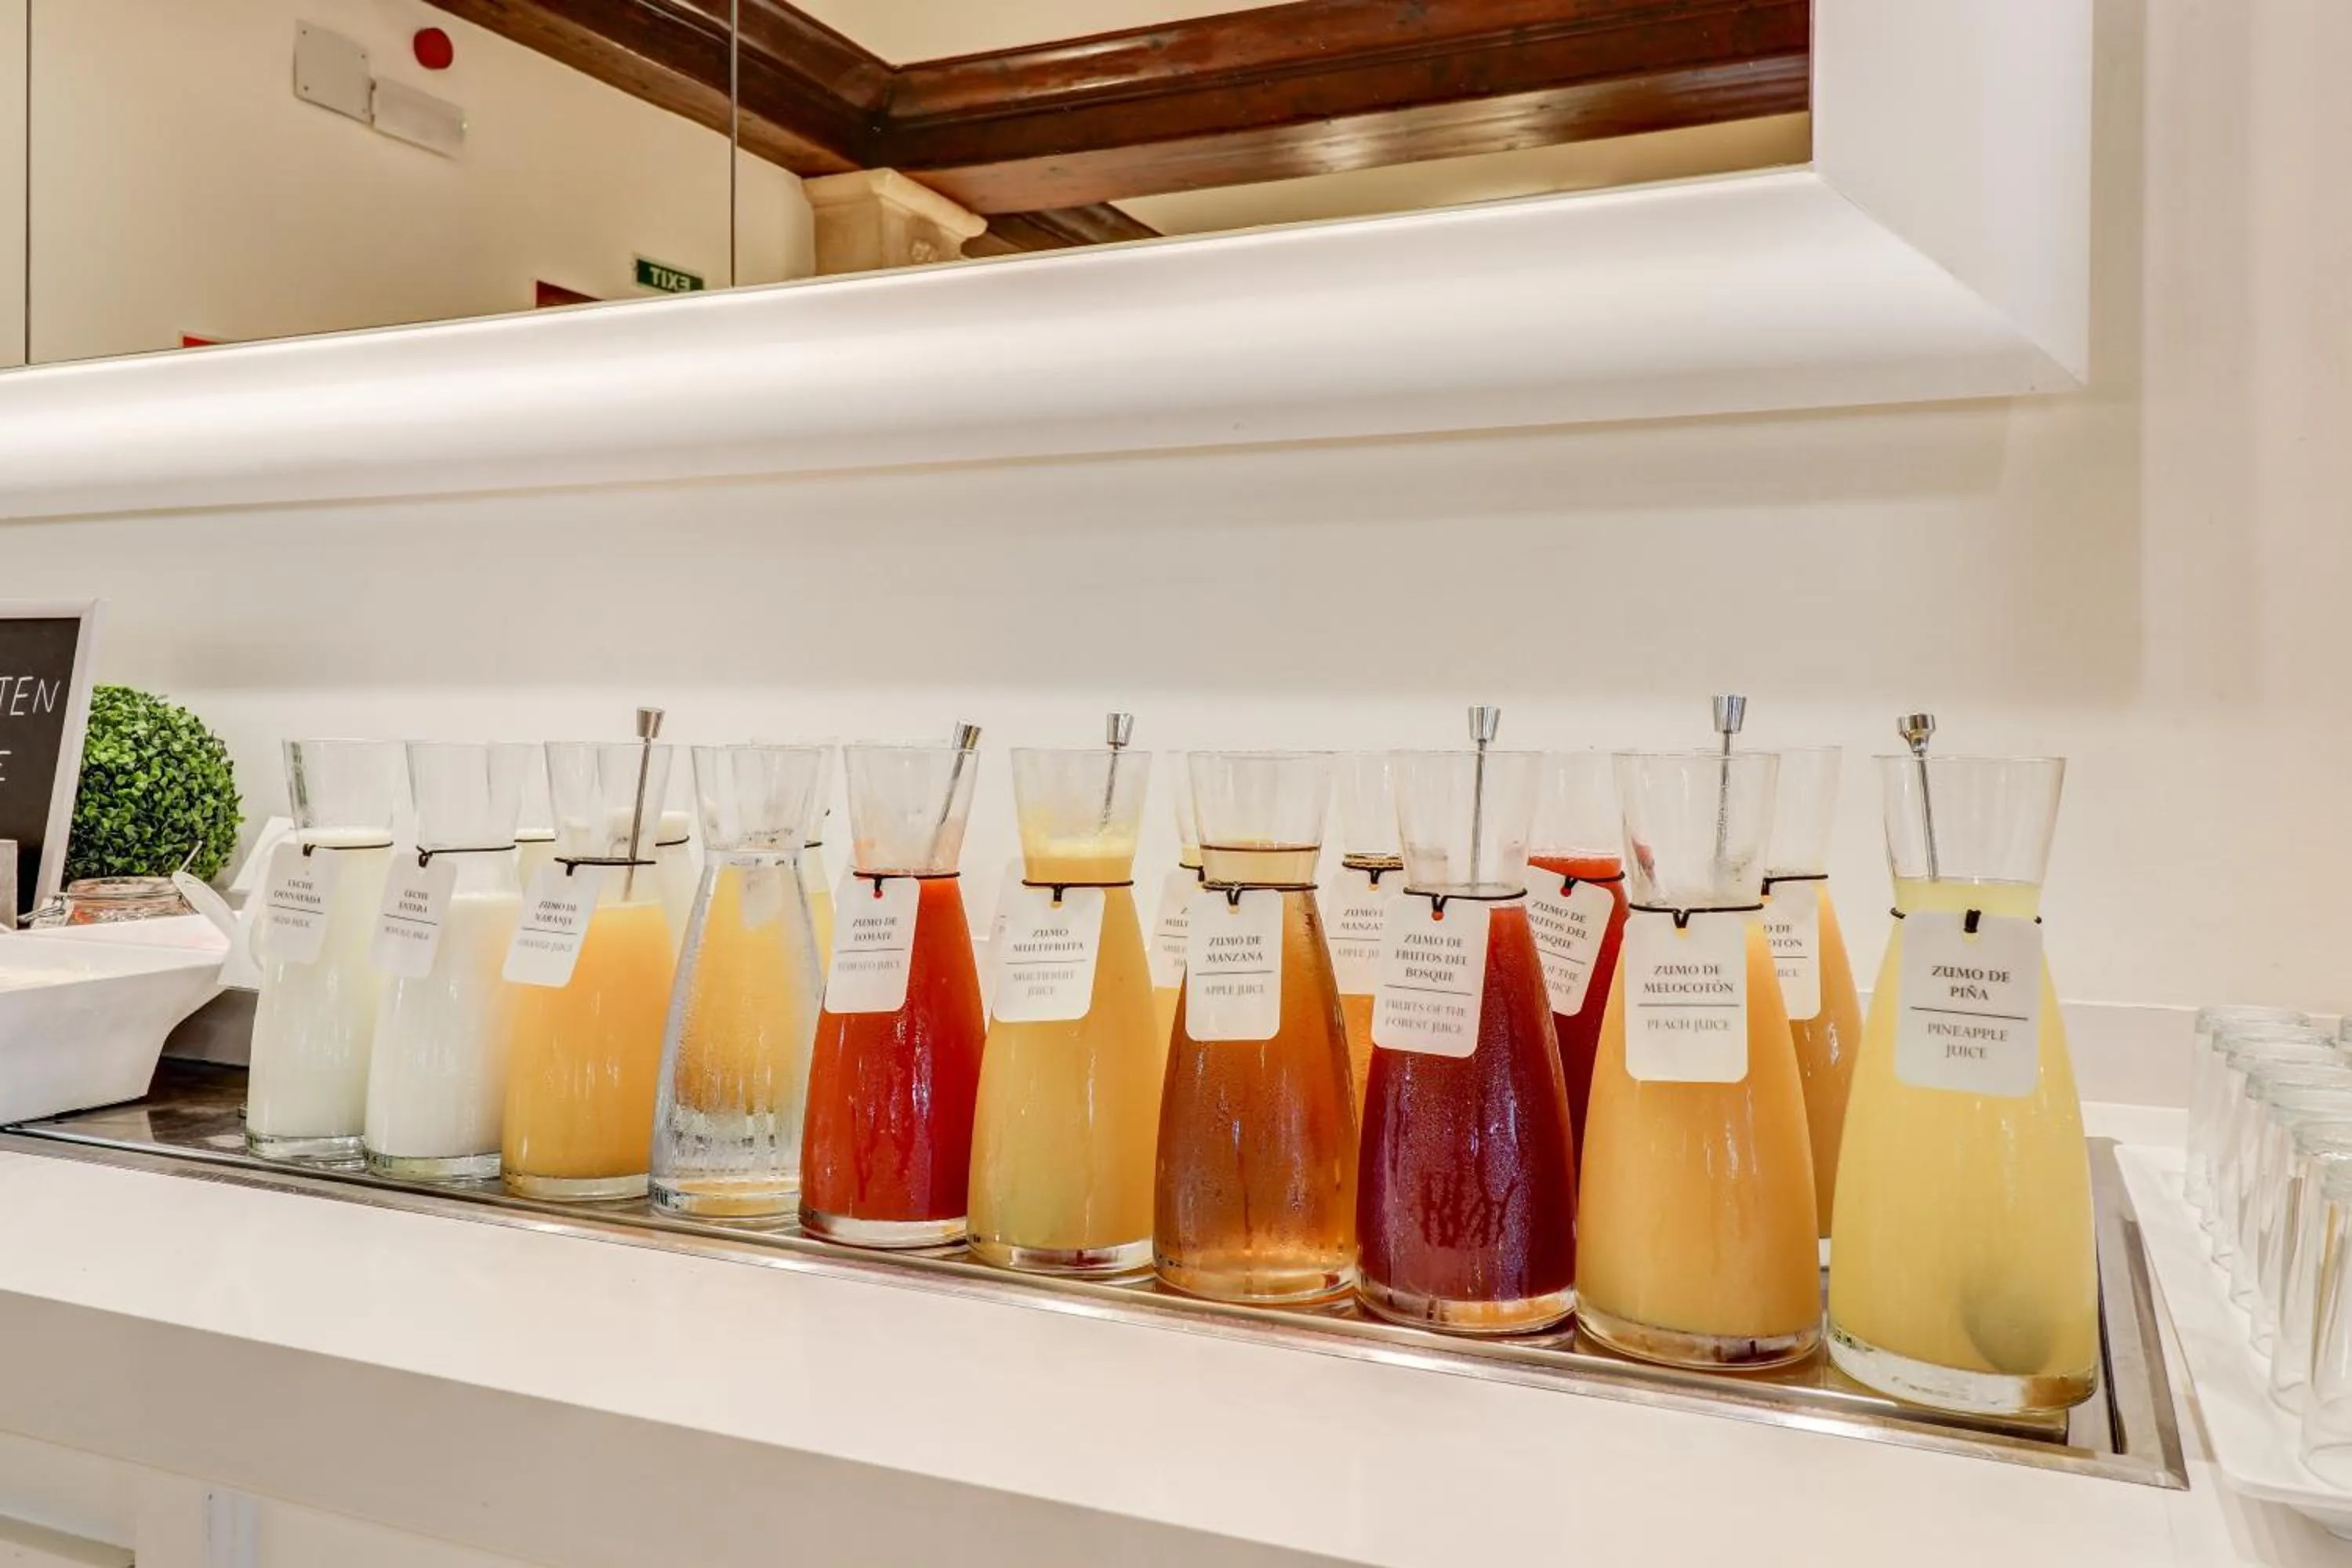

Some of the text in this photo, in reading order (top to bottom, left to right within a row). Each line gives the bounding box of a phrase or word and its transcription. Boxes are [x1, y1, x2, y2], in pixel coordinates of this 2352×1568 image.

[1343, 908, 1377, 916] ZUMO
[1532, 900, 1588, 924] ZUMO DE
[852, 916, 898, 927] ZUMO DE
[1341, 921, 1383, 931] MANZA
[1528, 913, 1588, 941] RUTOS DEL
[1776, 924, 1792, 934] DE
[1031, 928, 1069, 938] ZUMO
[1531, 930, 1573, 949] OSQUE
[1208, 935, 1261, 947] ZUMO DE
[1404, 934, 1464, 948] ZUMO DE
[1205, 951, 1264, 964] MANZANA
[1395, 949, 1442, 964] FRUTOS
[1445, 953, 1468, 967] DEL
[1404, 967, 1455, 983] BOSQUE
[1653, 964, 1721, 976] ZUMO DE
[1931, 965, 2012, 983] ZUMO DE
[1204, 983, 1265, 996] APPLE JUICE
[1642, 978, 1735, 994] MELOCOTÓN
[1949, 984, 1989, 1000] PIÑA
[1646, 1018, 1731, 1033] PEACH JUICE
[1926, 1022, 2009, 1042] PINEAPPLE
[1945, 1044, 1988, 1060] JUICE
